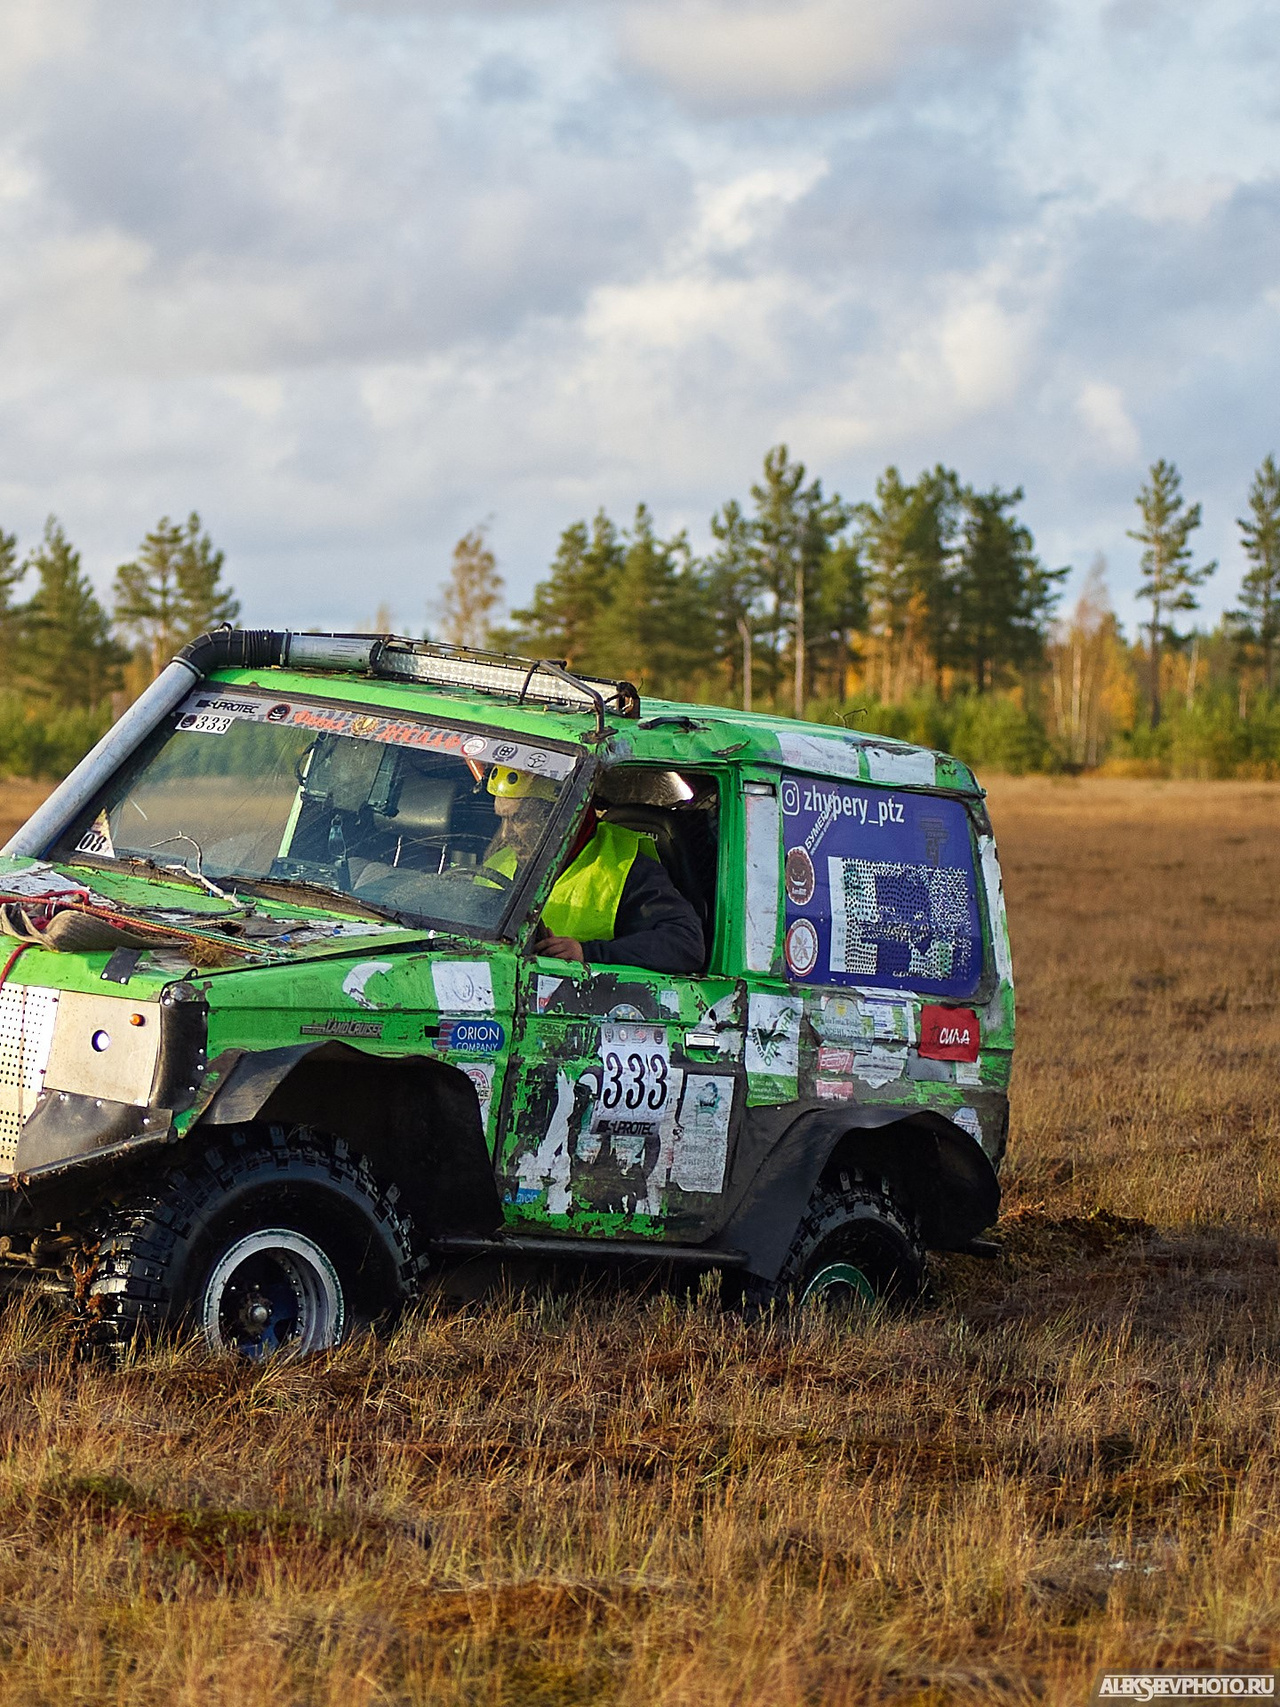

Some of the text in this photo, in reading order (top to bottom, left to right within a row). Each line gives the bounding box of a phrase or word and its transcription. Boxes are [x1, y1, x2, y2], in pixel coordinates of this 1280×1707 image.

[208, 701, 260, 714] SUPROTEC
[195, 715, 231, 734] 333
[803, 784, 905, 827] zhypery_ptz
[457, 1026, 500, 1041] ORION
[456, 1042, 498, 1052] COMPANY
[603, 1052, 668, 1110] 333
[607, 1121, 656, 1135] SUPROTEC
